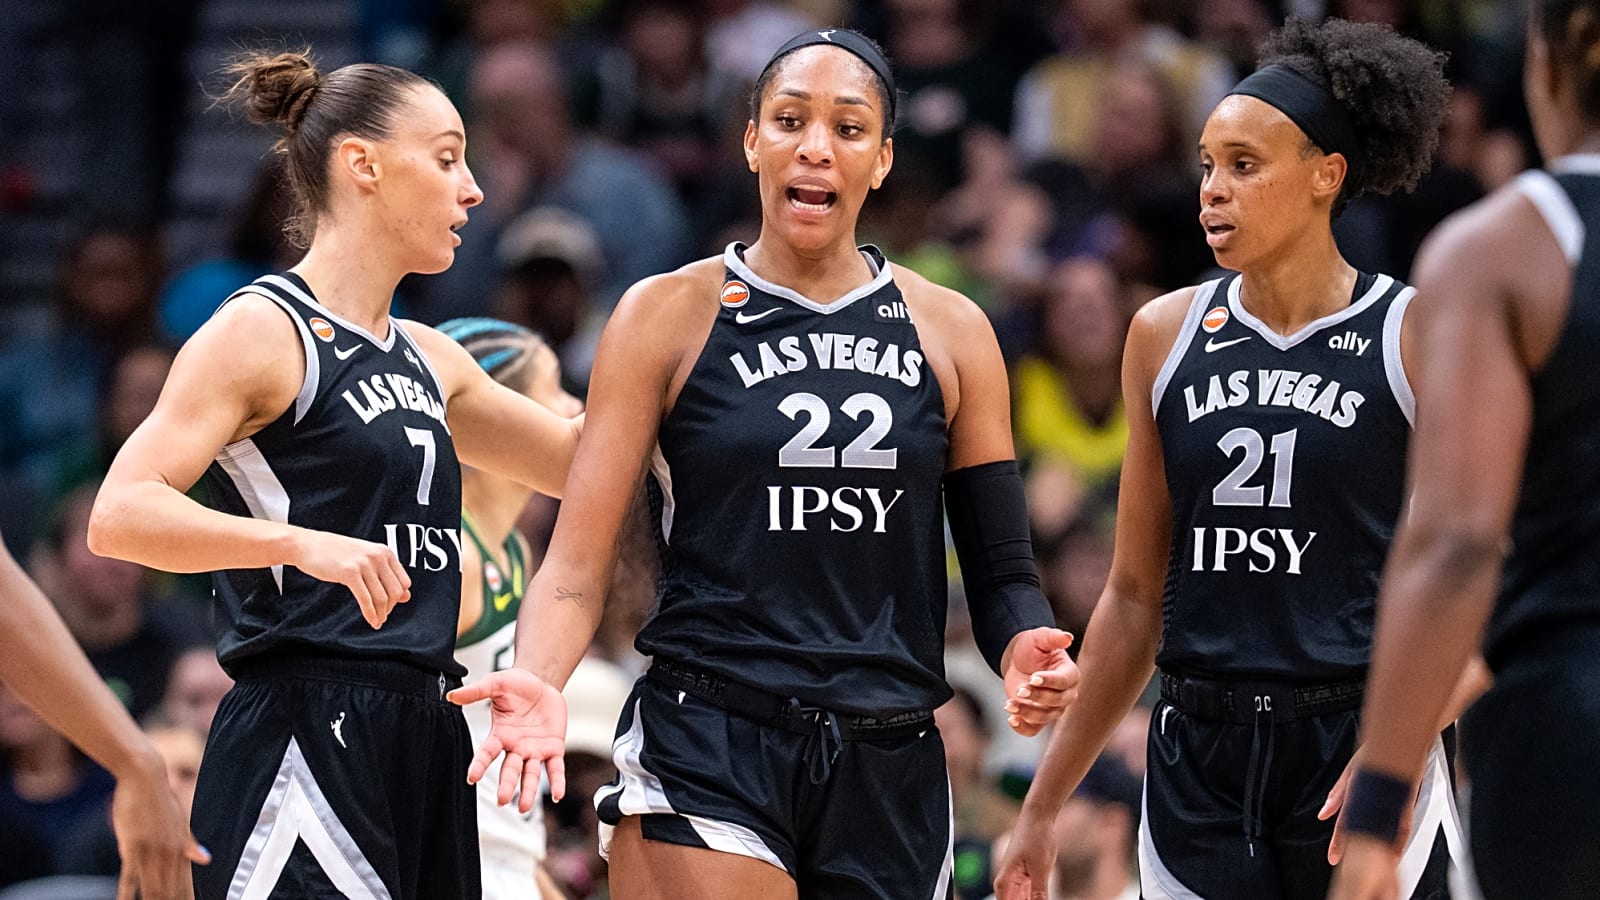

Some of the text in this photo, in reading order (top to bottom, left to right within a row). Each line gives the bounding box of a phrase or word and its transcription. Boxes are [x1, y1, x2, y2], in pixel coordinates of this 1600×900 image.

[729, 333, 924, 389] LAS VEGAS
[1328, 331, 1372, 356] ally
[341, 374, 397, 425] LAS
[1183, 369, 1366, 429] LAS VEGAS
[777, 392, 898, 470] 22
[403, 425, 437, 506] 7
[1212, 427, 1298, 508] 21
[766, 485, 905, 533] IPSY
[1191, 527, 1318, 575] IPSY
